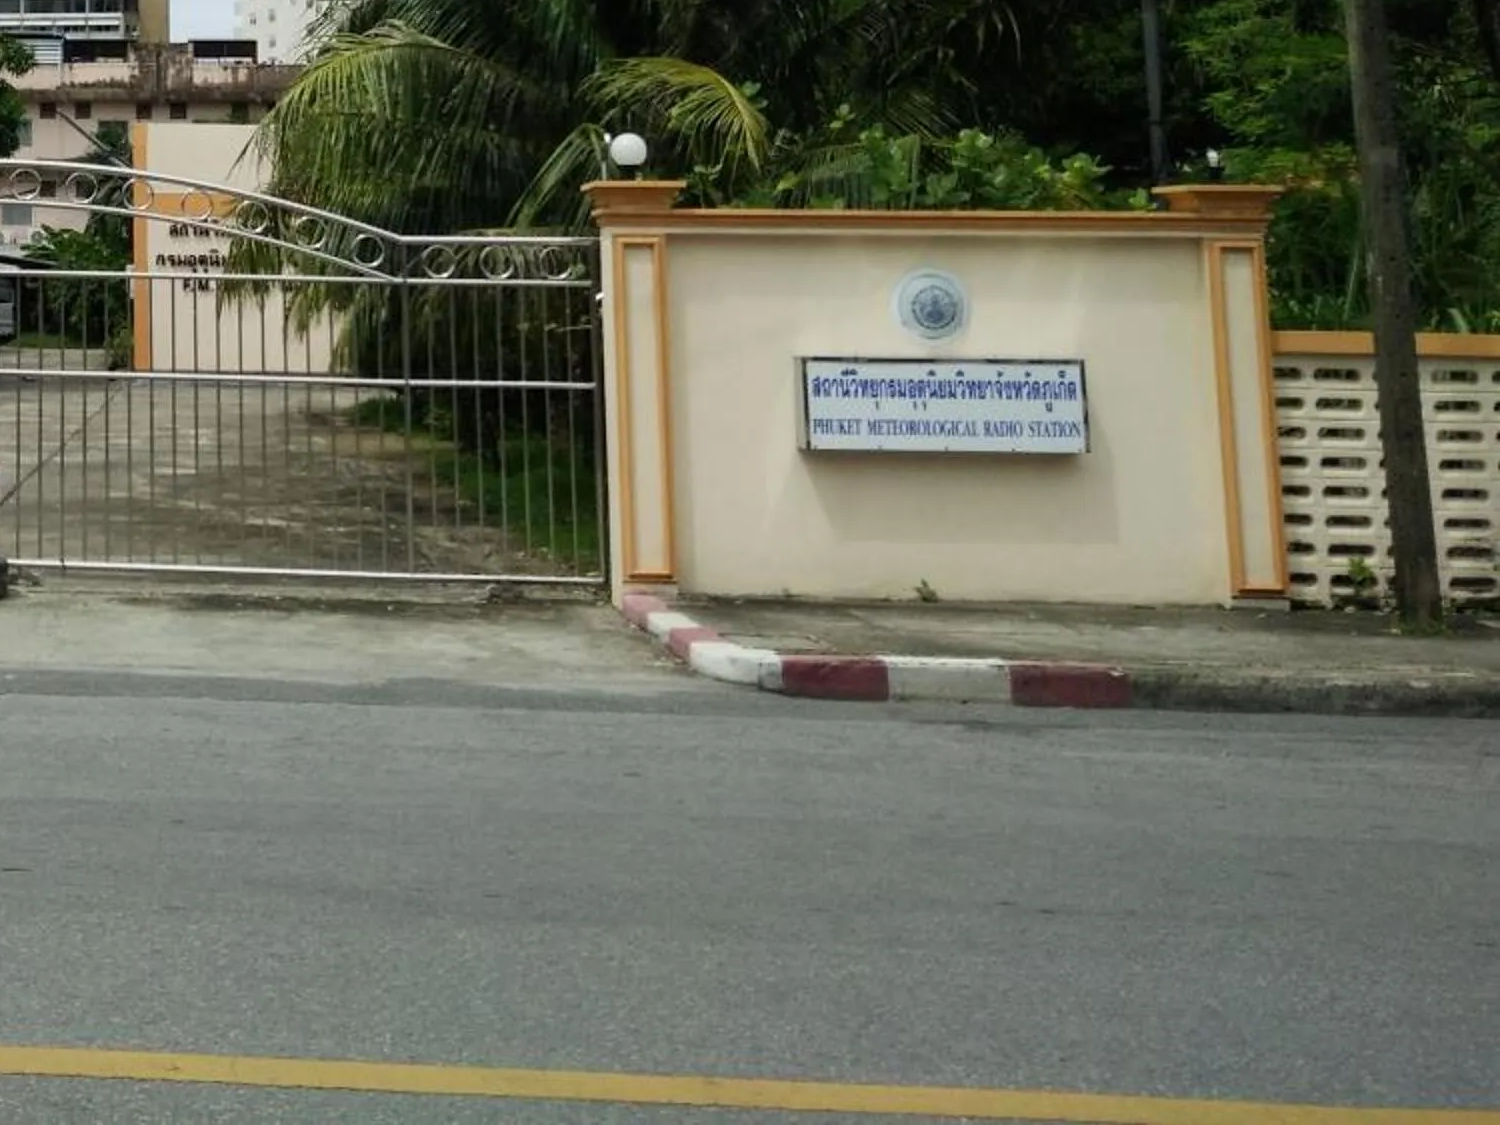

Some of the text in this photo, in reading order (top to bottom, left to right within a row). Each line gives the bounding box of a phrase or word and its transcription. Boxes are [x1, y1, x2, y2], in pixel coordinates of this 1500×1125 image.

[812, 417, 1082, 438] PHUKET METEOROLOGICAL RADIO STATION
